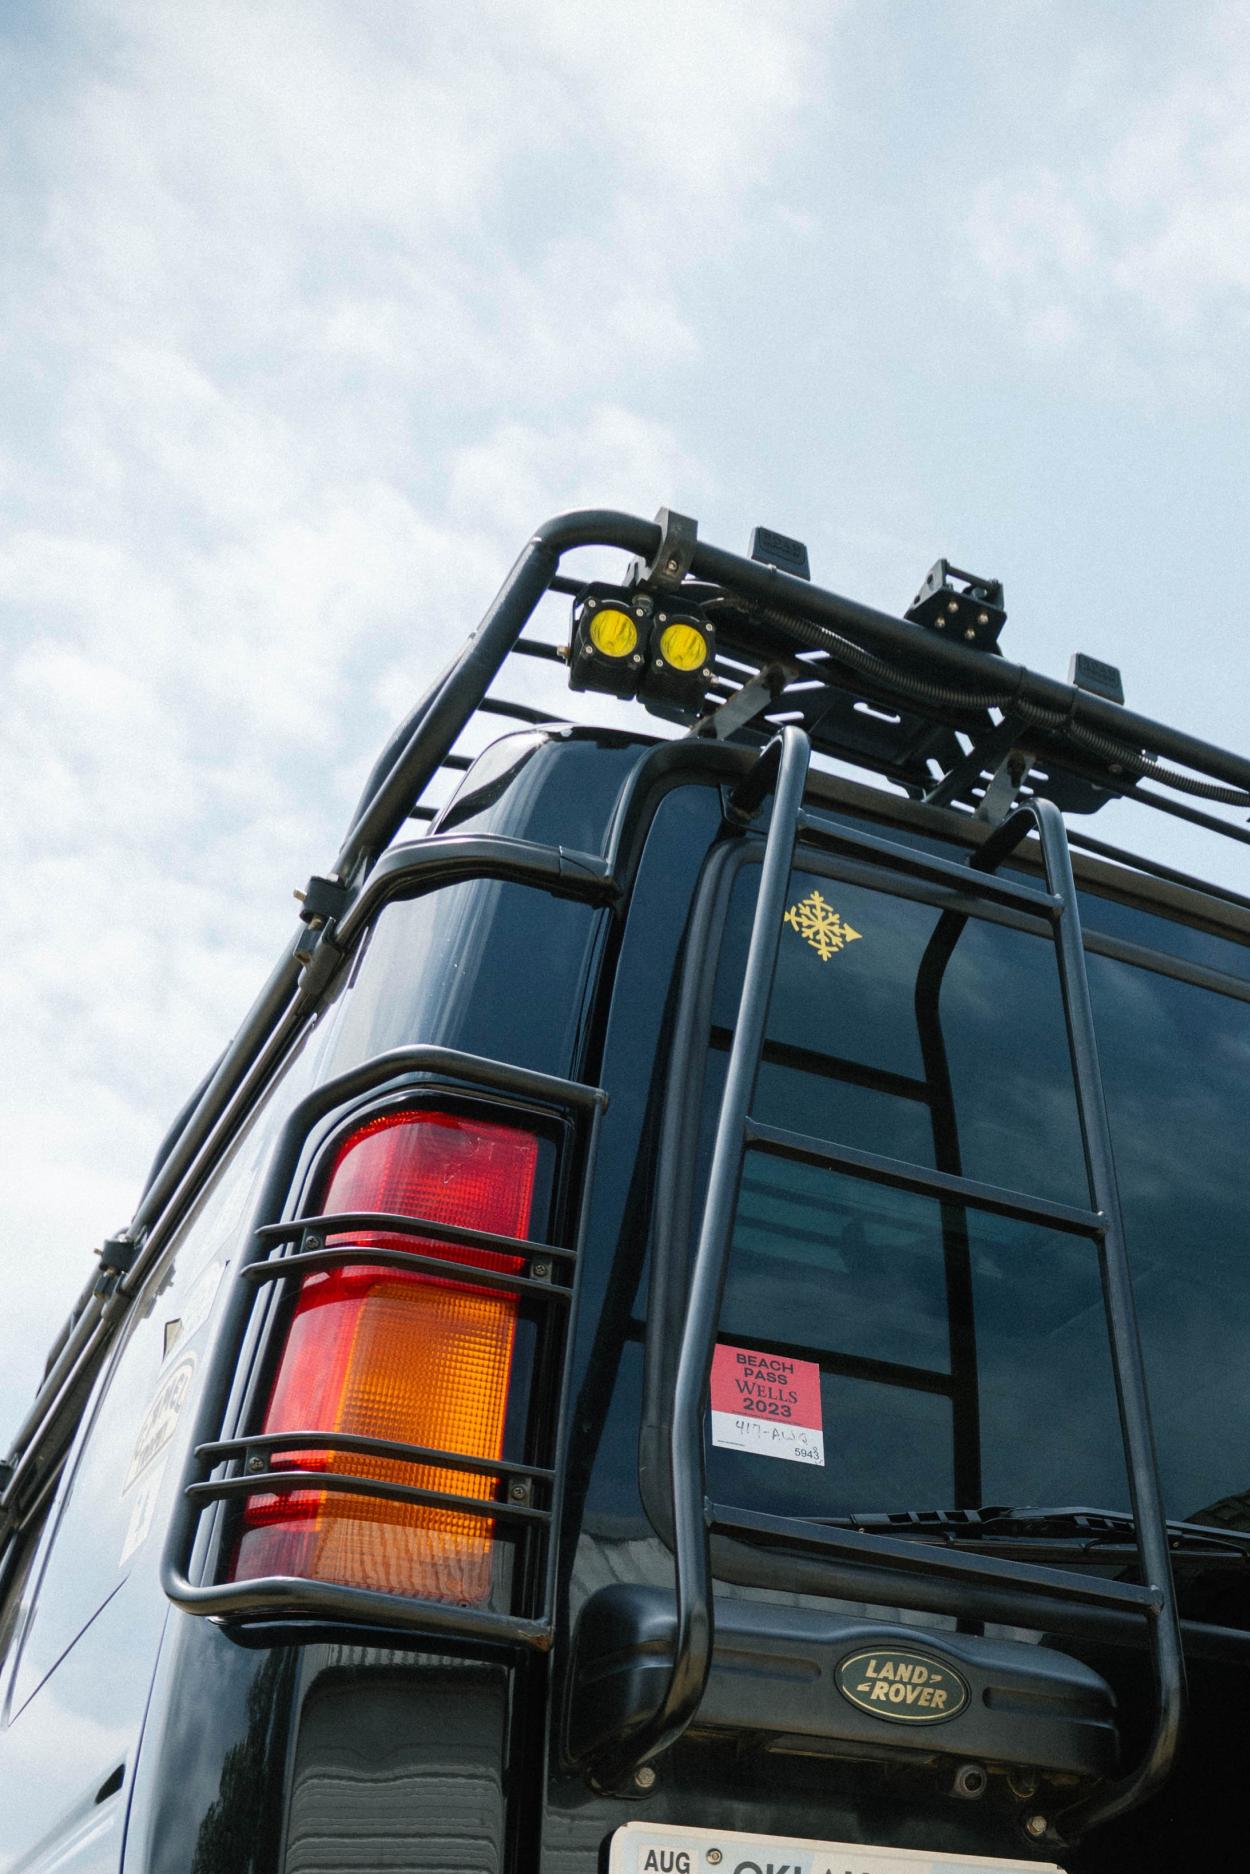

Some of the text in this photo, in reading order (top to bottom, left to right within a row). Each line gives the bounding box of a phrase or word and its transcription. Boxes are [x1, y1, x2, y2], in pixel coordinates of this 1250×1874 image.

[736, 1353, 795, 1374] BEACH
[744, 1367, 788, 1386] PASS
[735, 1379, 798, 1404] WELLS
[743, 1398, 792, 1418] 2023
[865, 1659, 928, 1684] LAND
[870, 1681, 948, 1709] ROVER
[644, 1849, 690, 1874] AUG
